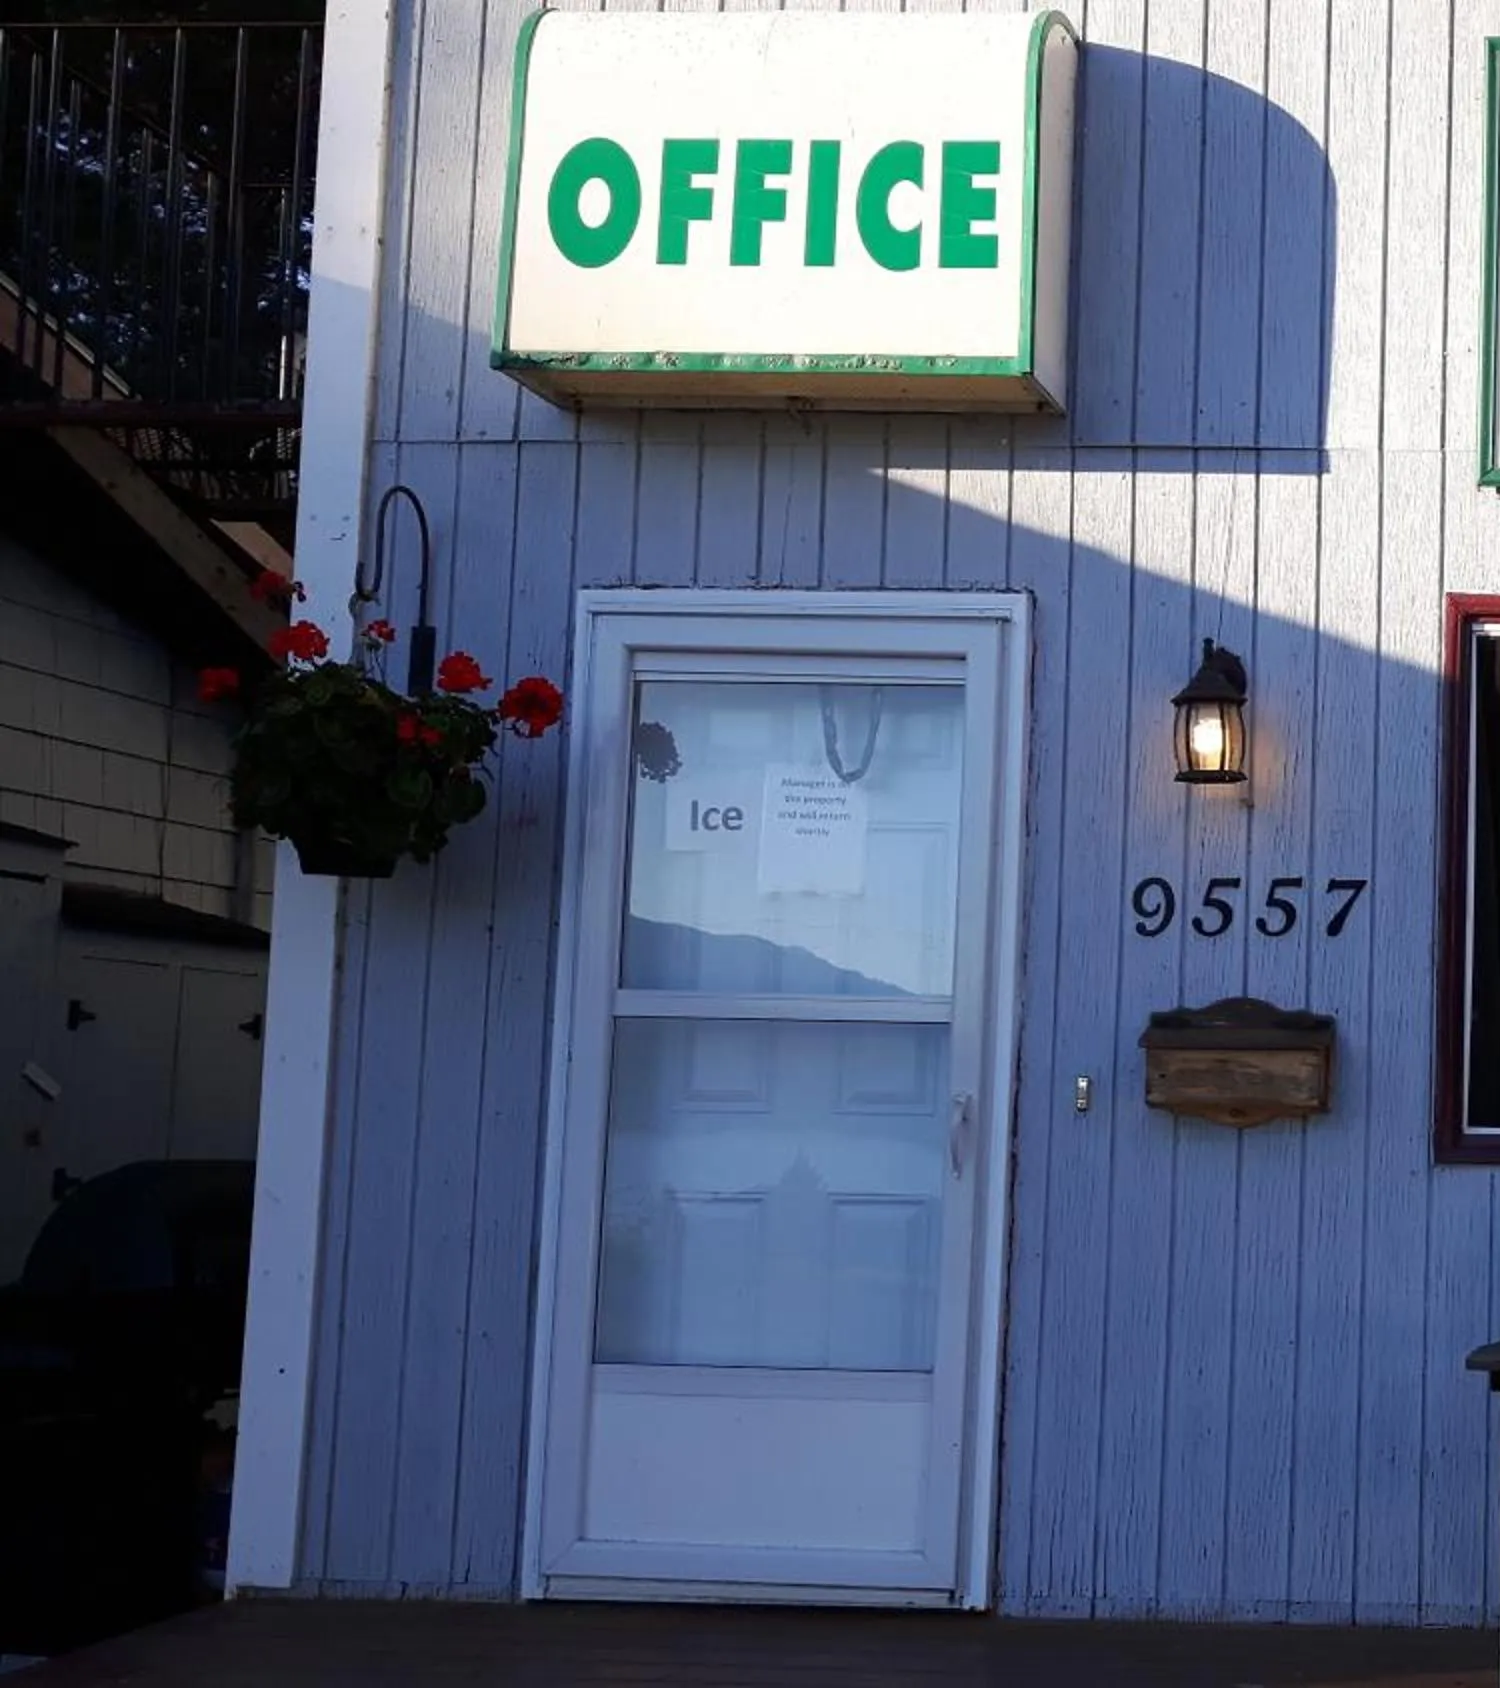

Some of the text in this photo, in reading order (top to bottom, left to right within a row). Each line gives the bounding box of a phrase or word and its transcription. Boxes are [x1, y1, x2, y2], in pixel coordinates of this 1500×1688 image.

[548, 137, 1001, 271] OFFICE
[691, 800, 743, 831] Ice
[1132, 877, 1368, 937] 9557
